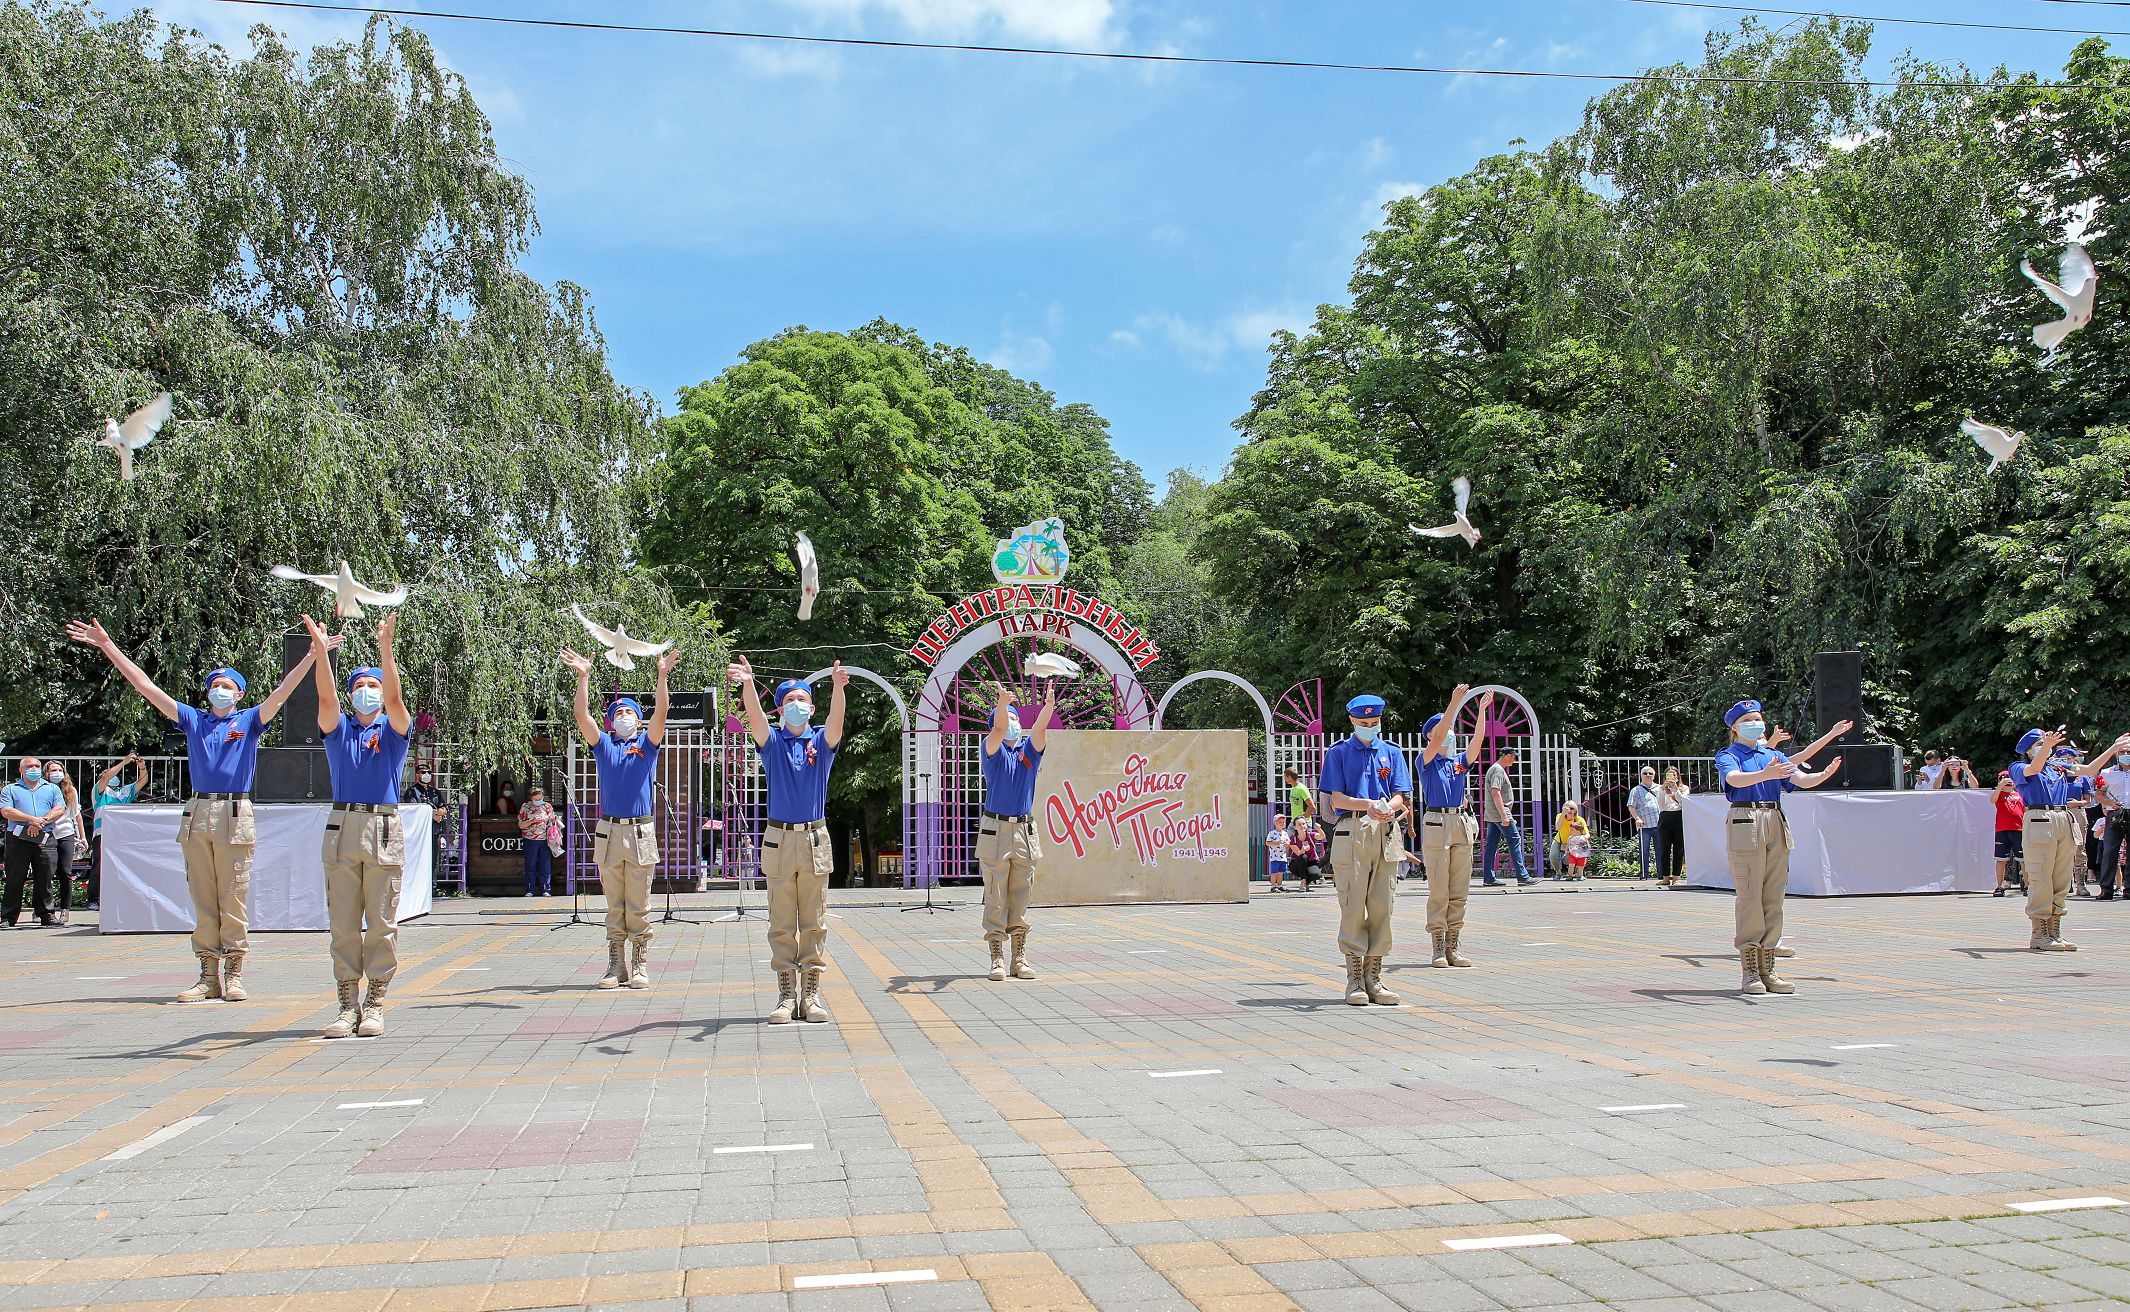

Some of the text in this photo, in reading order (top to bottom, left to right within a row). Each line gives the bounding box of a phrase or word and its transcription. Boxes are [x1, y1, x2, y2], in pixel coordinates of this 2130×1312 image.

[909, 584, 1159, 672] ЦЕНТРАЛЬНЫЙ
[997, 613, 1075, 639] ПАРК
[1046, 753, 1188, 858] Народная
[1117, 794, 1222, 867] Победа!
